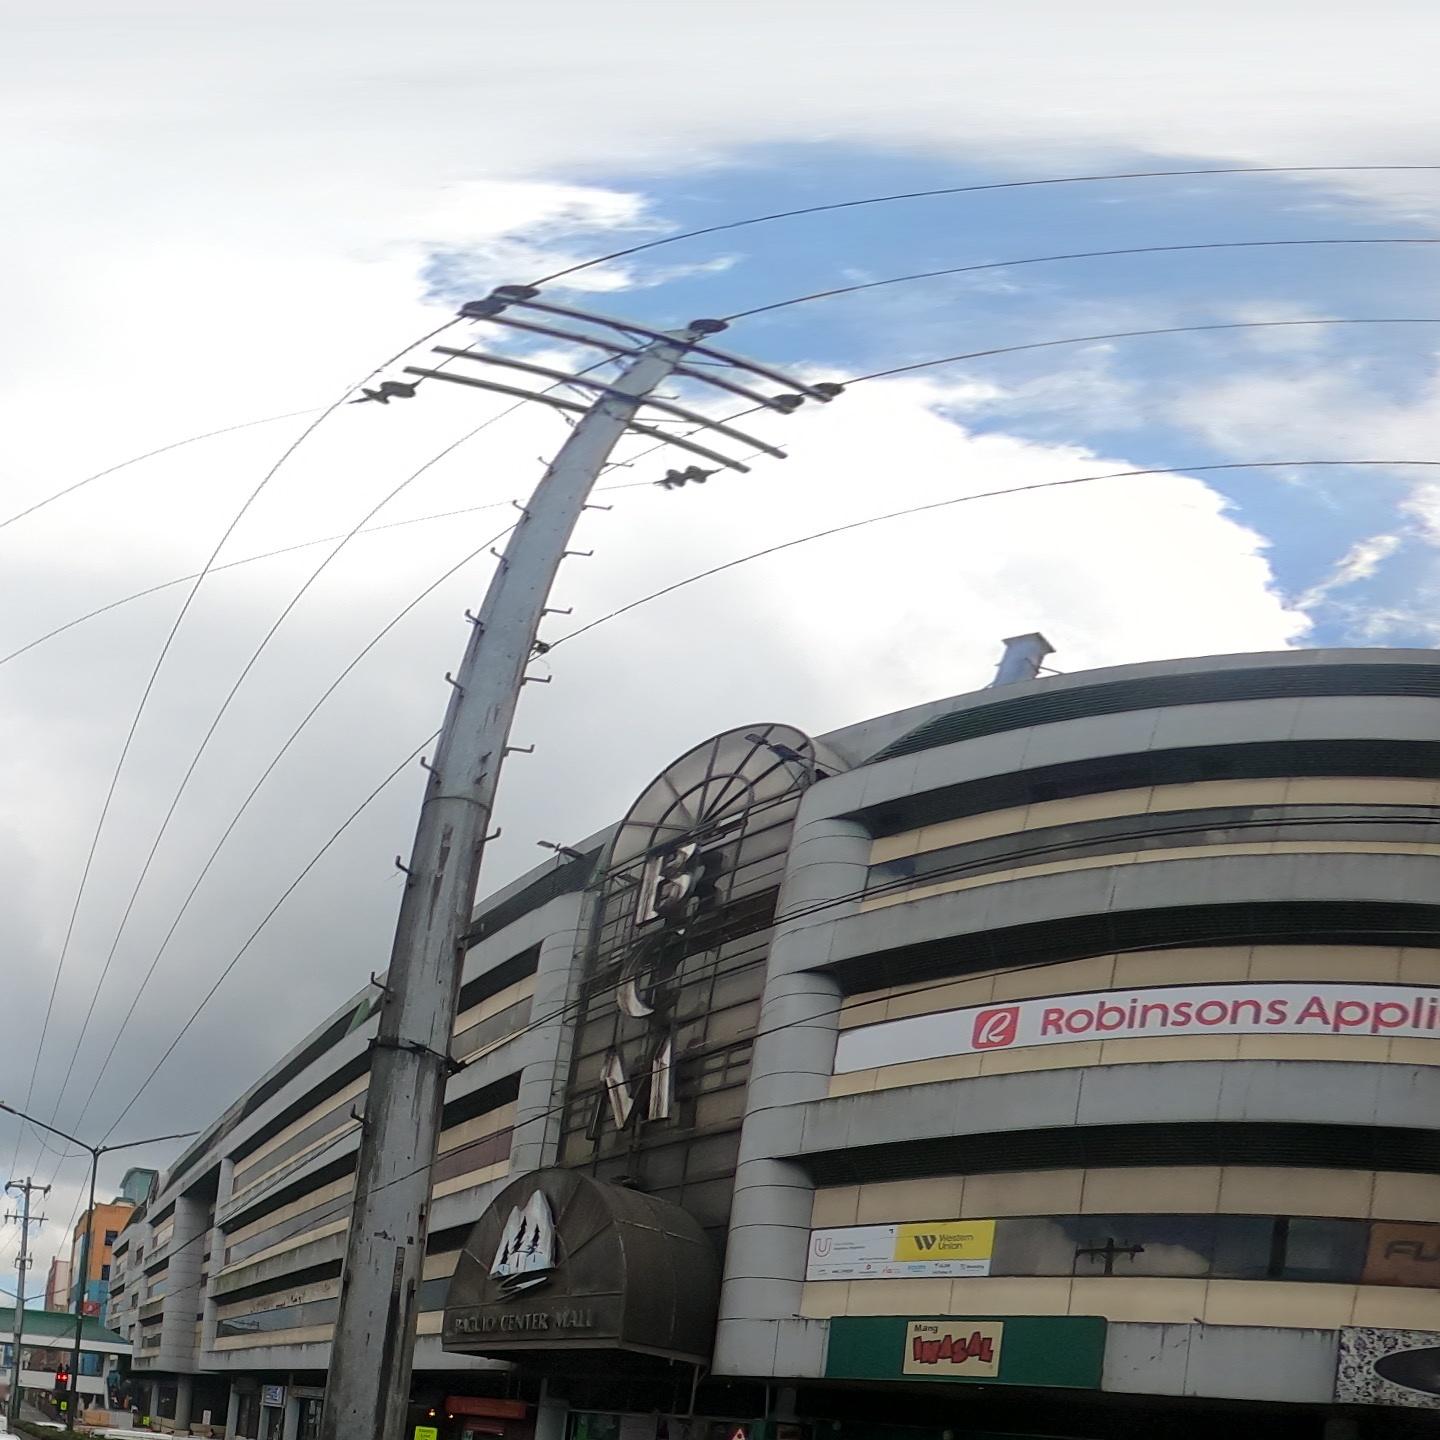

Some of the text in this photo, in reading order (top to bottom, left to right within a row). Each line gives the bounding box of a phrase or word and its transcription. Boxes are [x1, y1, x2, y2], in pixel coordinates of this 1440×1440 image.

[1040, 998, 1289, 1036] Robinsons
[939, 1234, 974, 1242] Western
[939, 1242, 963, 1250] Union
[501, 1312, 549, 1331] CENTER
[556, 1309, 592, 1329] MALL
[914, 1324, 938, 1333] Mang
